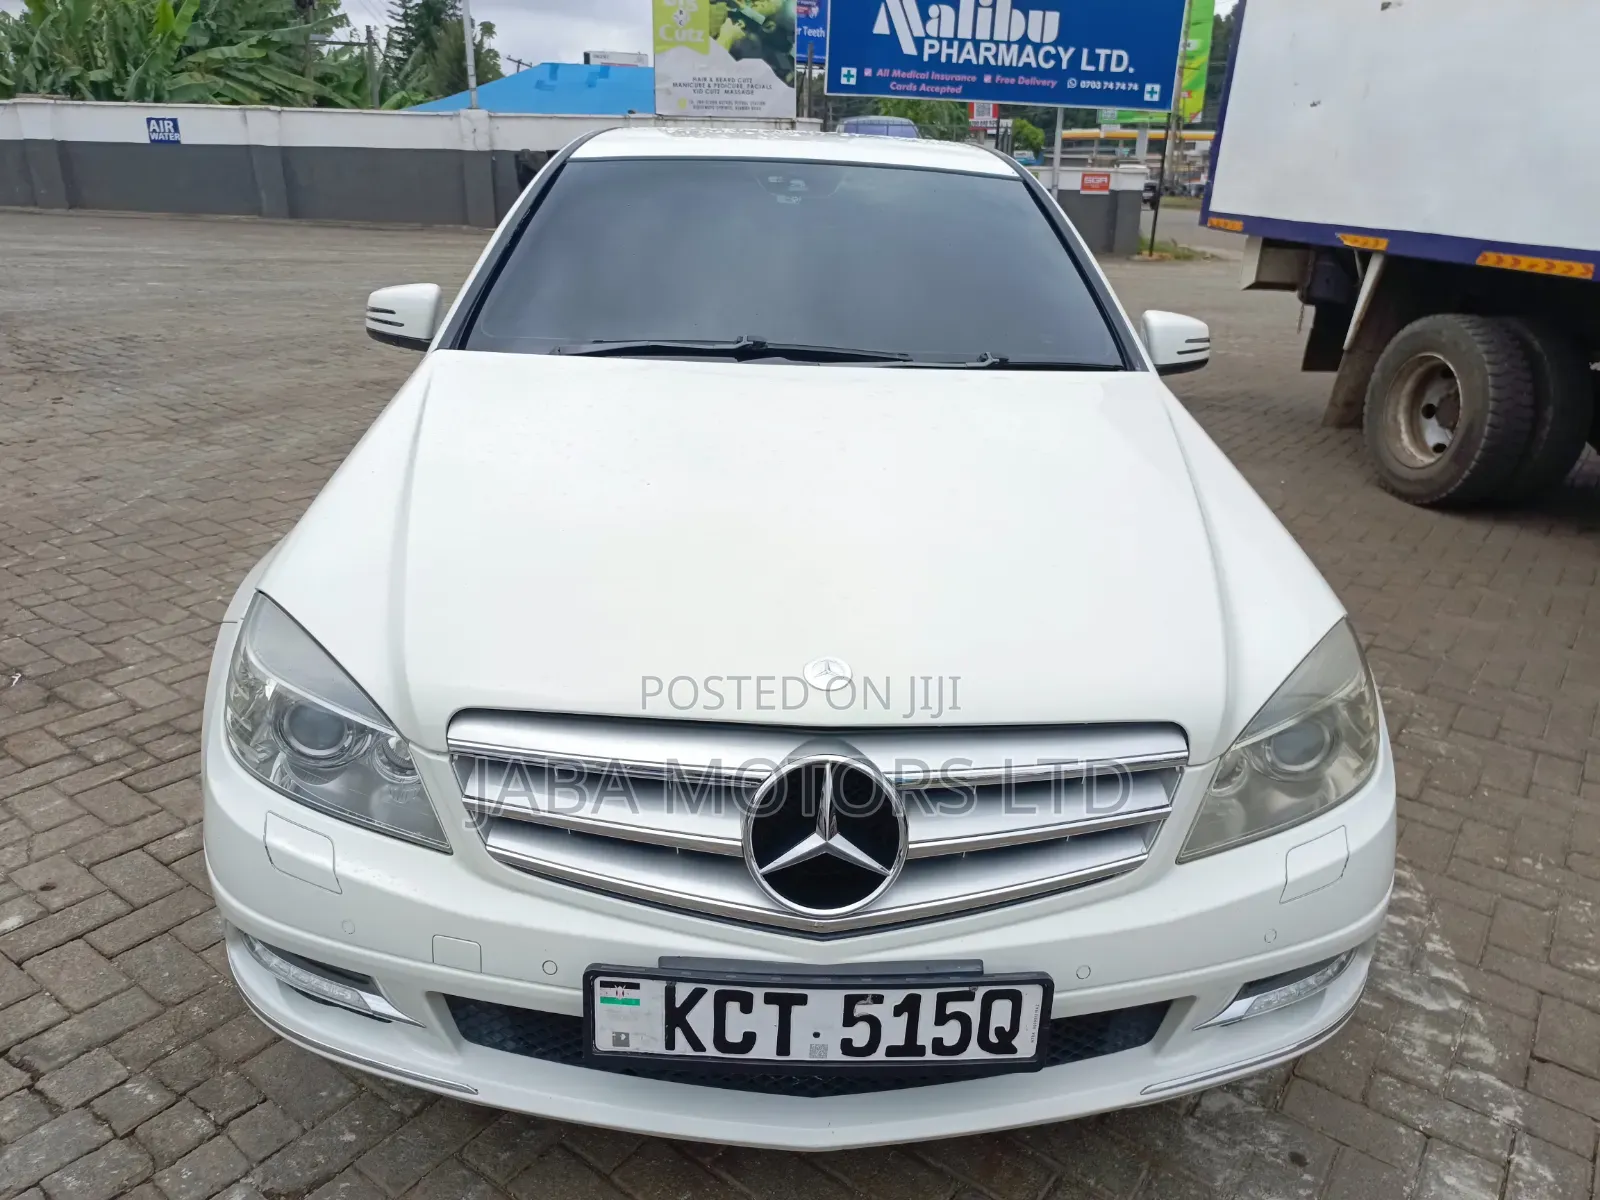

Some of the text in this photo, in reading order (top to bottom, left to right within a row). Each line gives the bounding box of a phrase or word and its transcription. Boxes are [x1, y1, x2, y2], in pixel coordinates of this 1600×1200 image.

[659, 24, 705, 42] Cutz
[802, 25, 826, 38] Teeth
[872, 0, 1060, 55] Malibu
[923, 38, 1135, 74] PHARMACY LTD.
[876, 68, 890, 77] All
[891, 68, 929, 80] Medical
[931, 70, 977, 83] Insurance
[995, 75, 1016, 85] Free
[1018, 75, 1058, 89] Delivery
[889, 81, 963, 95] Cards Accepted
[150, 119, 174, 133] AIR
[150, 132, 180, 141] WATER
[664, 985, 1023, 1058] KCT 515Q
